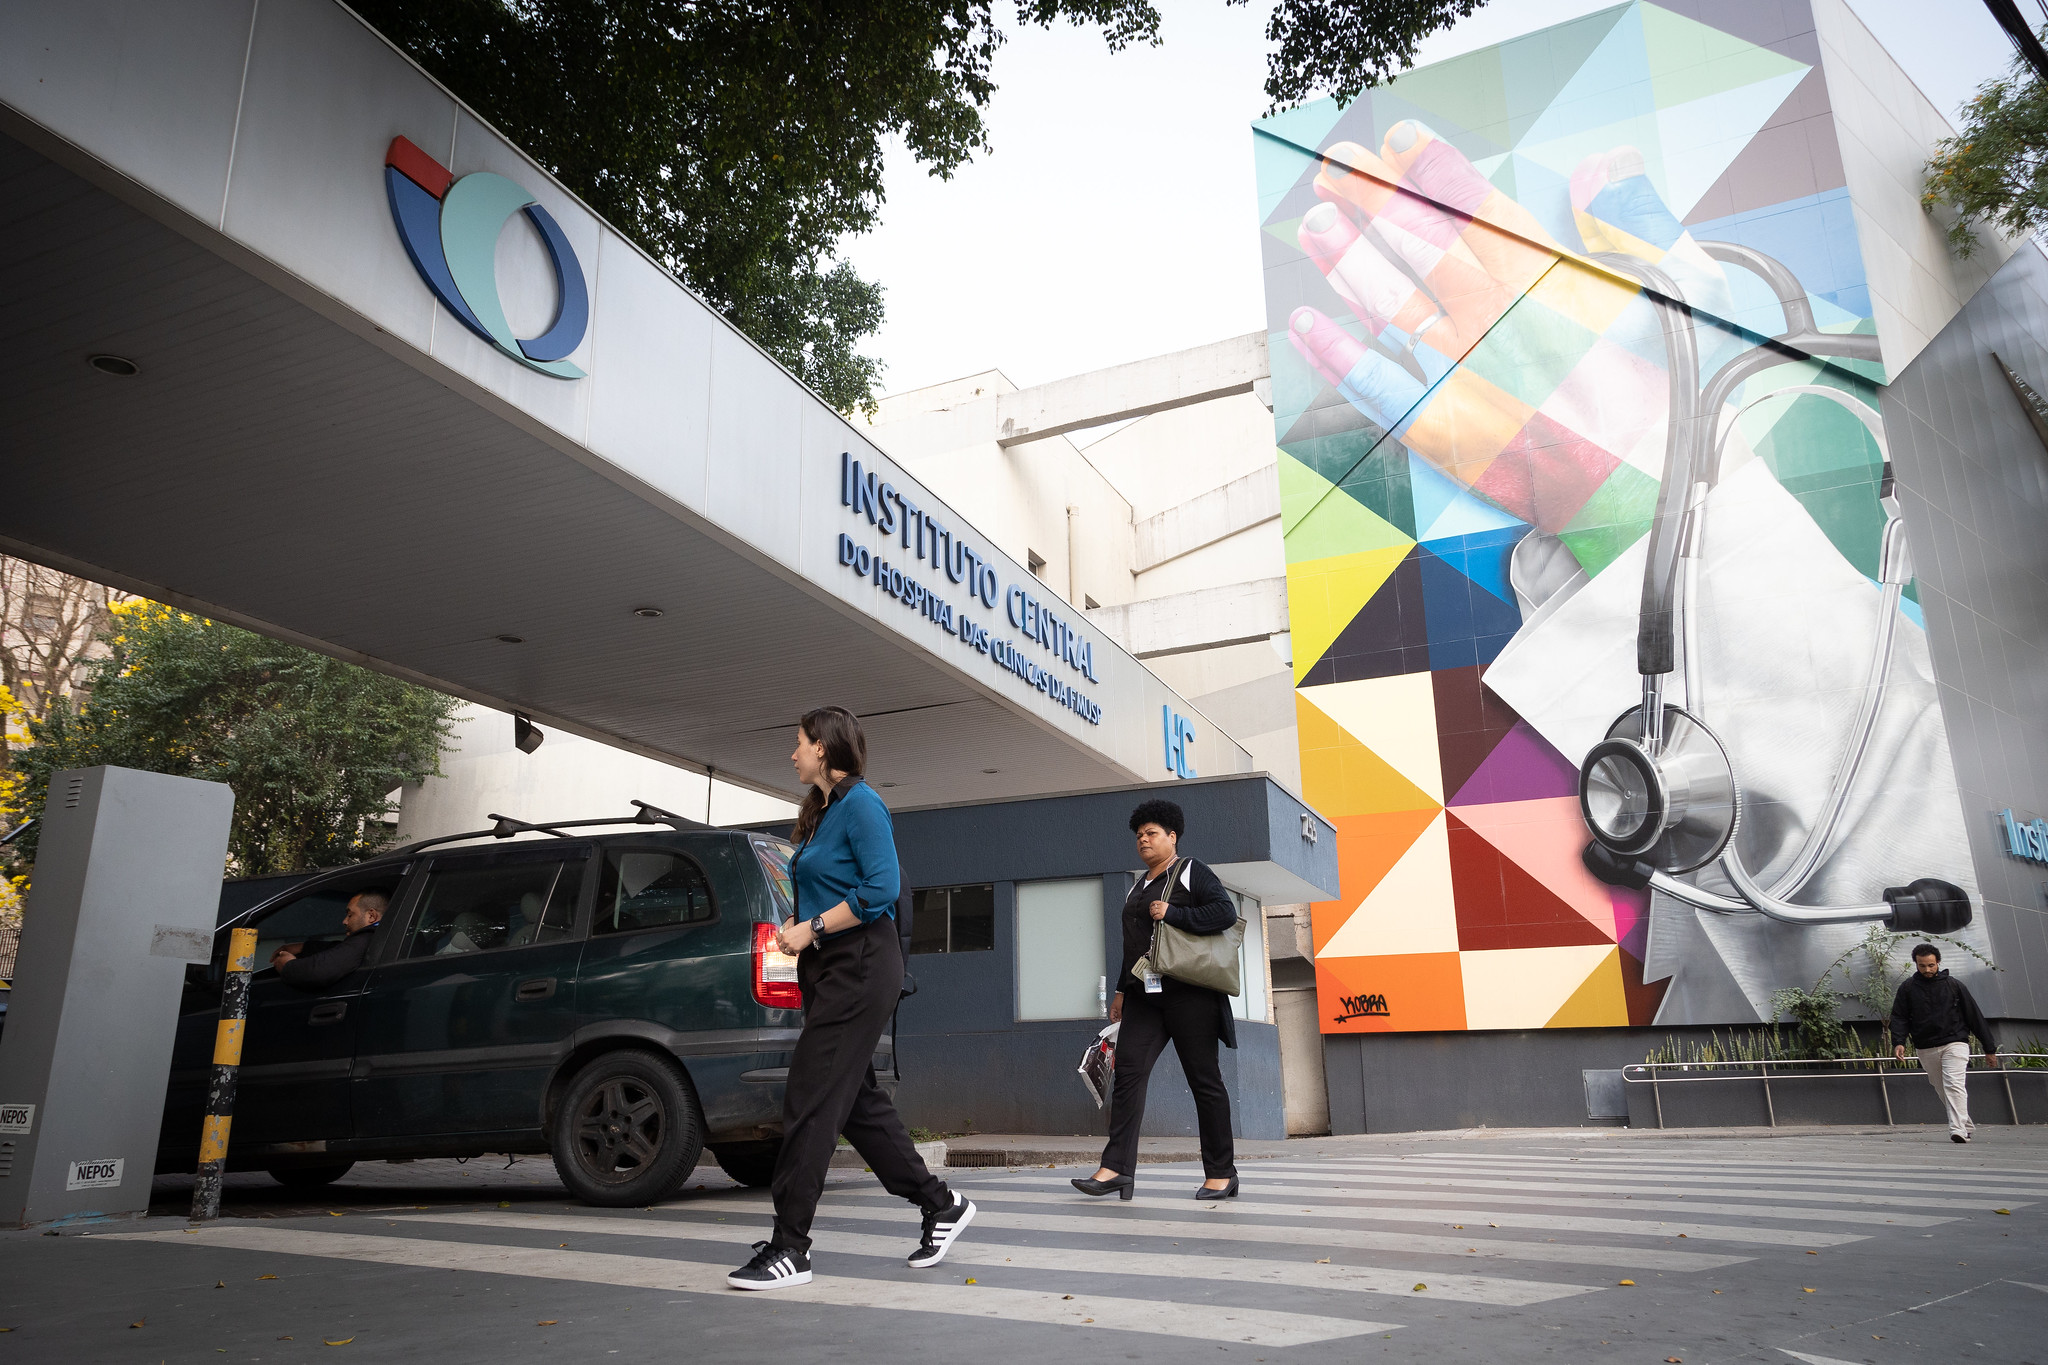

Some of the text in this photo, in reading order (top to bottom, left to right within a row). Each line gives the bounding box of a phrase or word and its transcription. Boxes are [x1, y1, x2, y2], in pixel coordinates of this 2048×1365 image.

[841, 451, 1099, 684] INSTITUTO CENTRAL
[839, 533, 1102, 726] DO HOSPITAL DAS CLÍNICAS DA FMUSP
[1163, 704, 1198, 779] HC
[1340, 994, 1388, 1014] KOBRA
[0, 1110, 28, 1124] NEPOS
[77, 1164, 115, 1180] NEPOS
